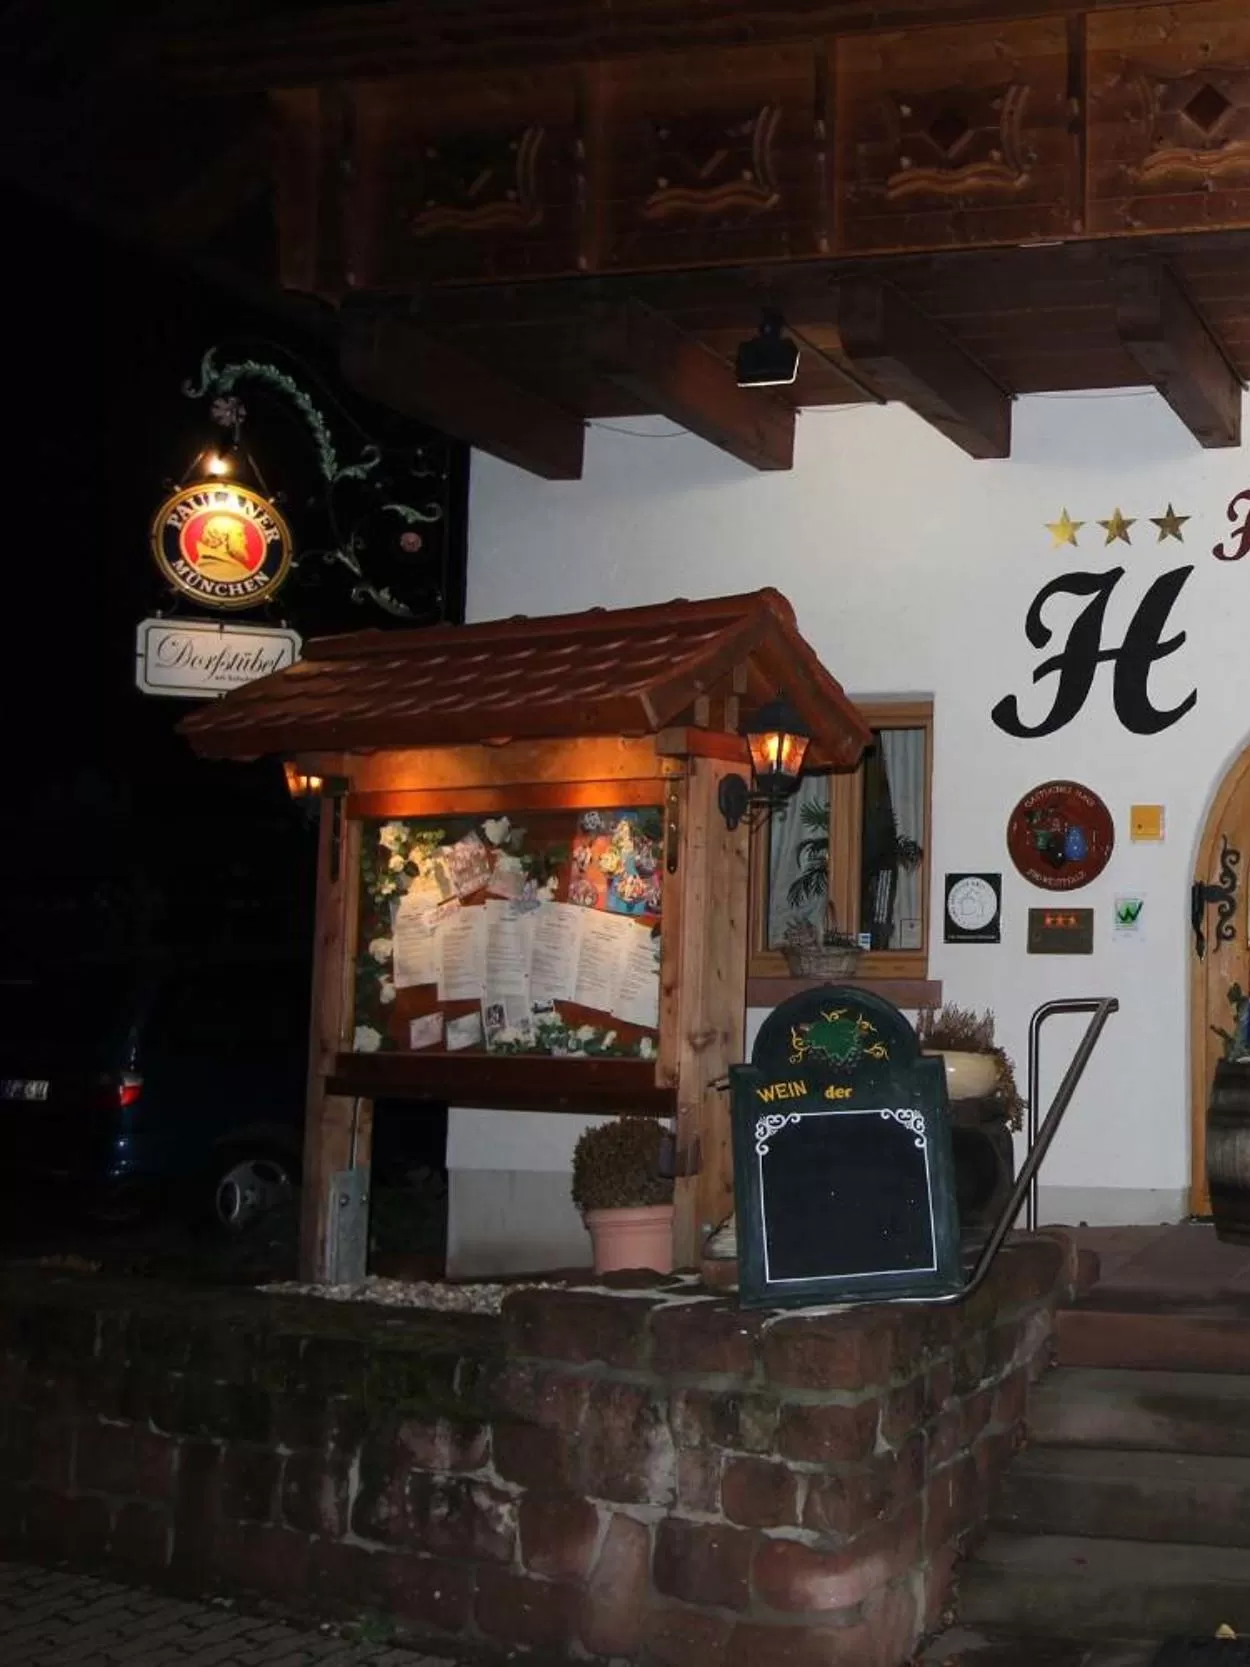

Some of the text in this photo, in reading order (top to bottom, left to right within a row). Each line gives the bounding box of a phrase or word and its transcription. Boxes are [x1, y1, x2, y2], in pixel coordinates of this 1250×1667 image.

[166, 491, 280, 544] PAULANER
[172, 558, 271, 597] MÜNCHEN
[156, 632, 286, 682] Dorfstübel
[991, 565, 1197, 738] H
[755, 1079, 854, 1104] WEIN der
